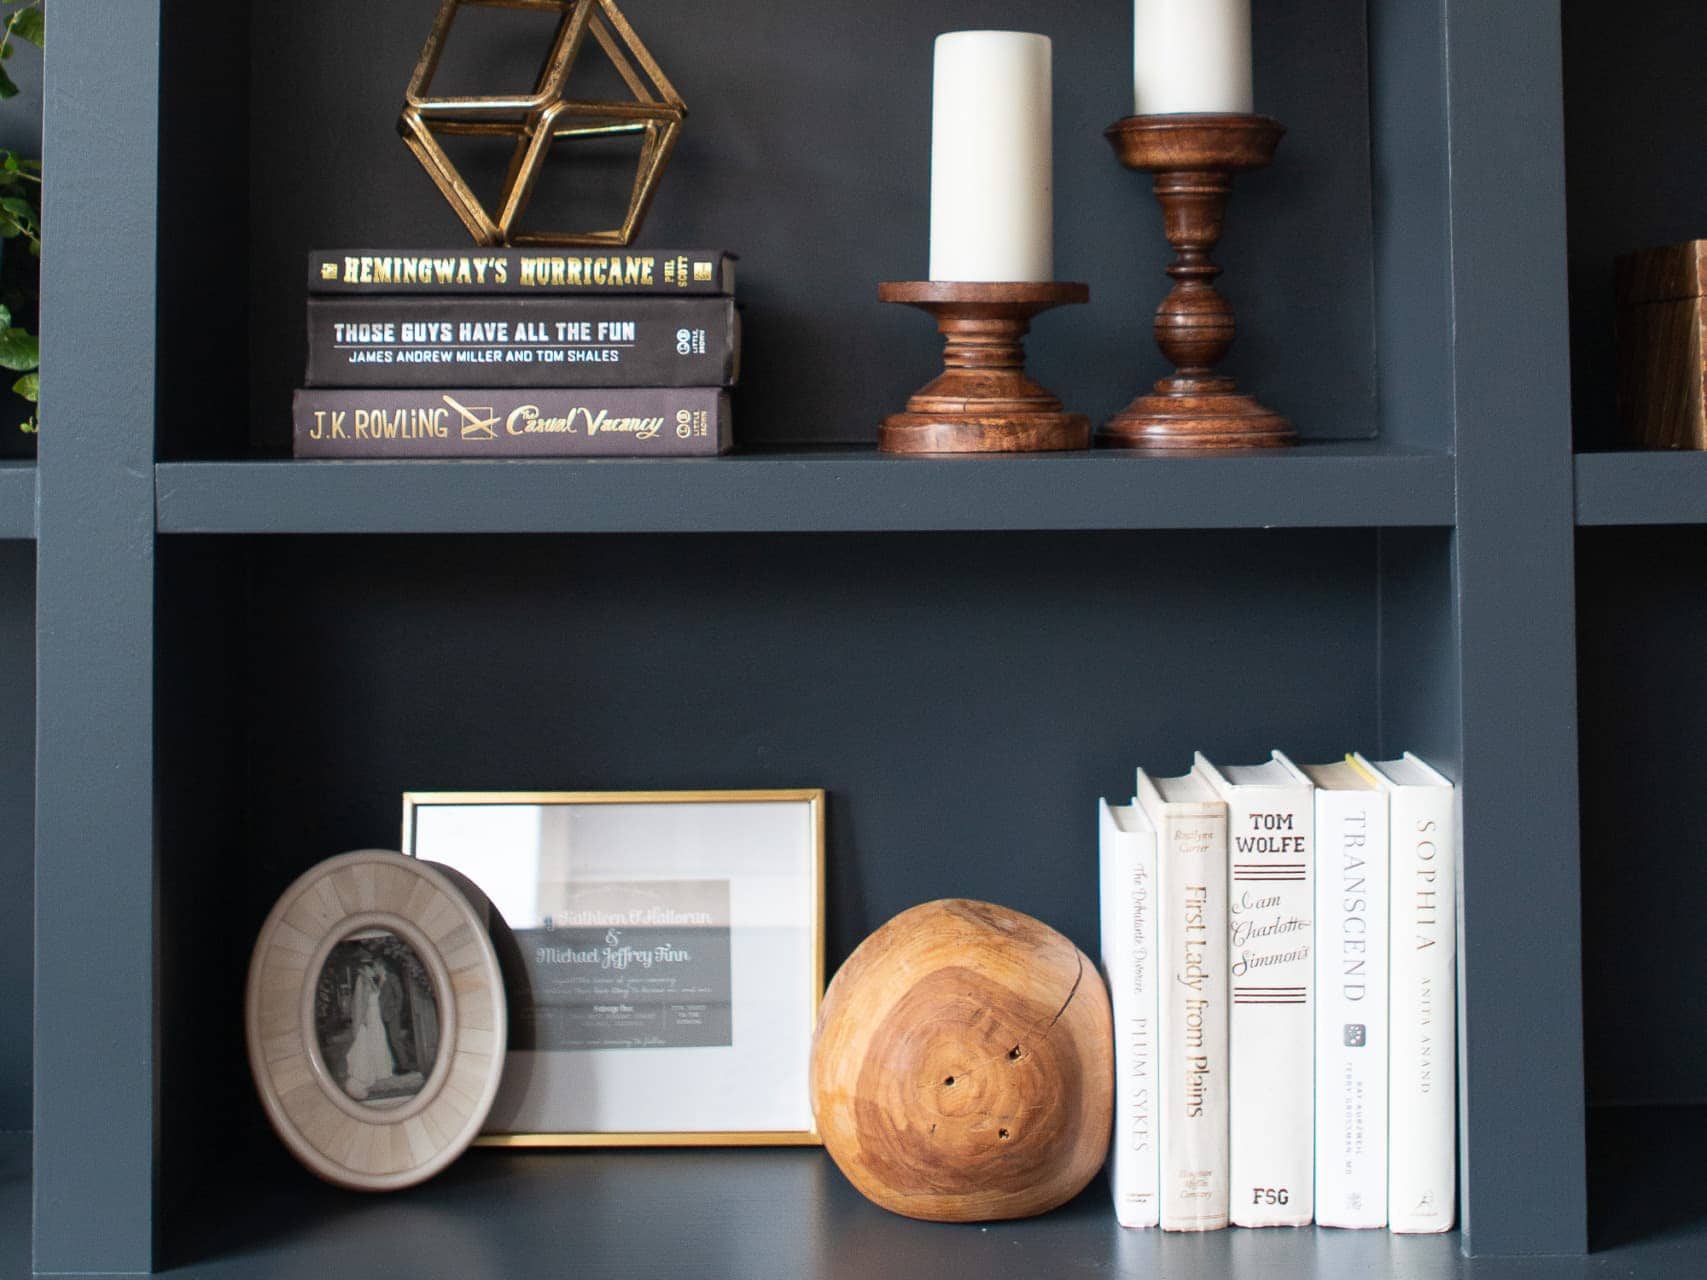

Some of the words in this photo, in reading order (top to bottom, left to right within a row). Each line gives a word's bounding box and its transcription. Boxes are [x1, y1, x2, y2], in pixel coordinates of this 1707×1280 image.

[343, 256, 508, 284] HEMINGWAY'S
[519, 256, 655, 287] HURRICANE
[664, 260, 675, 284] PHIL
[677, 255, 688, 288] SCOTT
[333, 323, 395, 343] THOSE
[401, 323, 453, 343] GUYS
[459, 323, 508, 343] HAVE
[515, 323, 550, 343] ALL
[556, 323, 593, 343] THE
[598, 323, 636, 343] FUN
[348, 349, 393, 364] JAMES
[396, 349, 453, 364] ANDREW
[456, 349, 503, 364] MILLER
[505, 349, 533, 364] AND
[536, 349, 565, 364] TOM
[567, 349, 619, 364] SHALES
[310, 411, 351, 440] J.K.
[355, 408, 449, 440] ROWLING
[506, 405, 578, 436] Casual
[577, 407, 664, 440] Vacancy
[1249, 813, 1293, 830] TOM
[1235, 836, 1305, 853] WOLFE
[1416, 820, 1437, 950] SOPHIA
[1185, 885, 1208, 933] First
[1255, 895, 1281, 910] am
[1343, 810, 1367, 1002] TRANSCEND
[1231, 915, 1312, 948] Charlotte
[535, 946, 600, 965] Michael
[600, 945, 653, 970] Jeffrey
[655, 943, 690, 963] Finn
[1177, 939, 1210, 992] Lady
[1421, 977, 1432, 1026] ANITA
[1186, 998, 1210, 1048] from
[1131, 1016, 1149, 1078] PLUM
[1421, 1033, 1432, 1095] ANAND
[1186, 1055, 1211, 1119] Plains
[1131, 1087, 1149, 1152] SYKES
[1252, 1188, 1289, 1206] FSG
